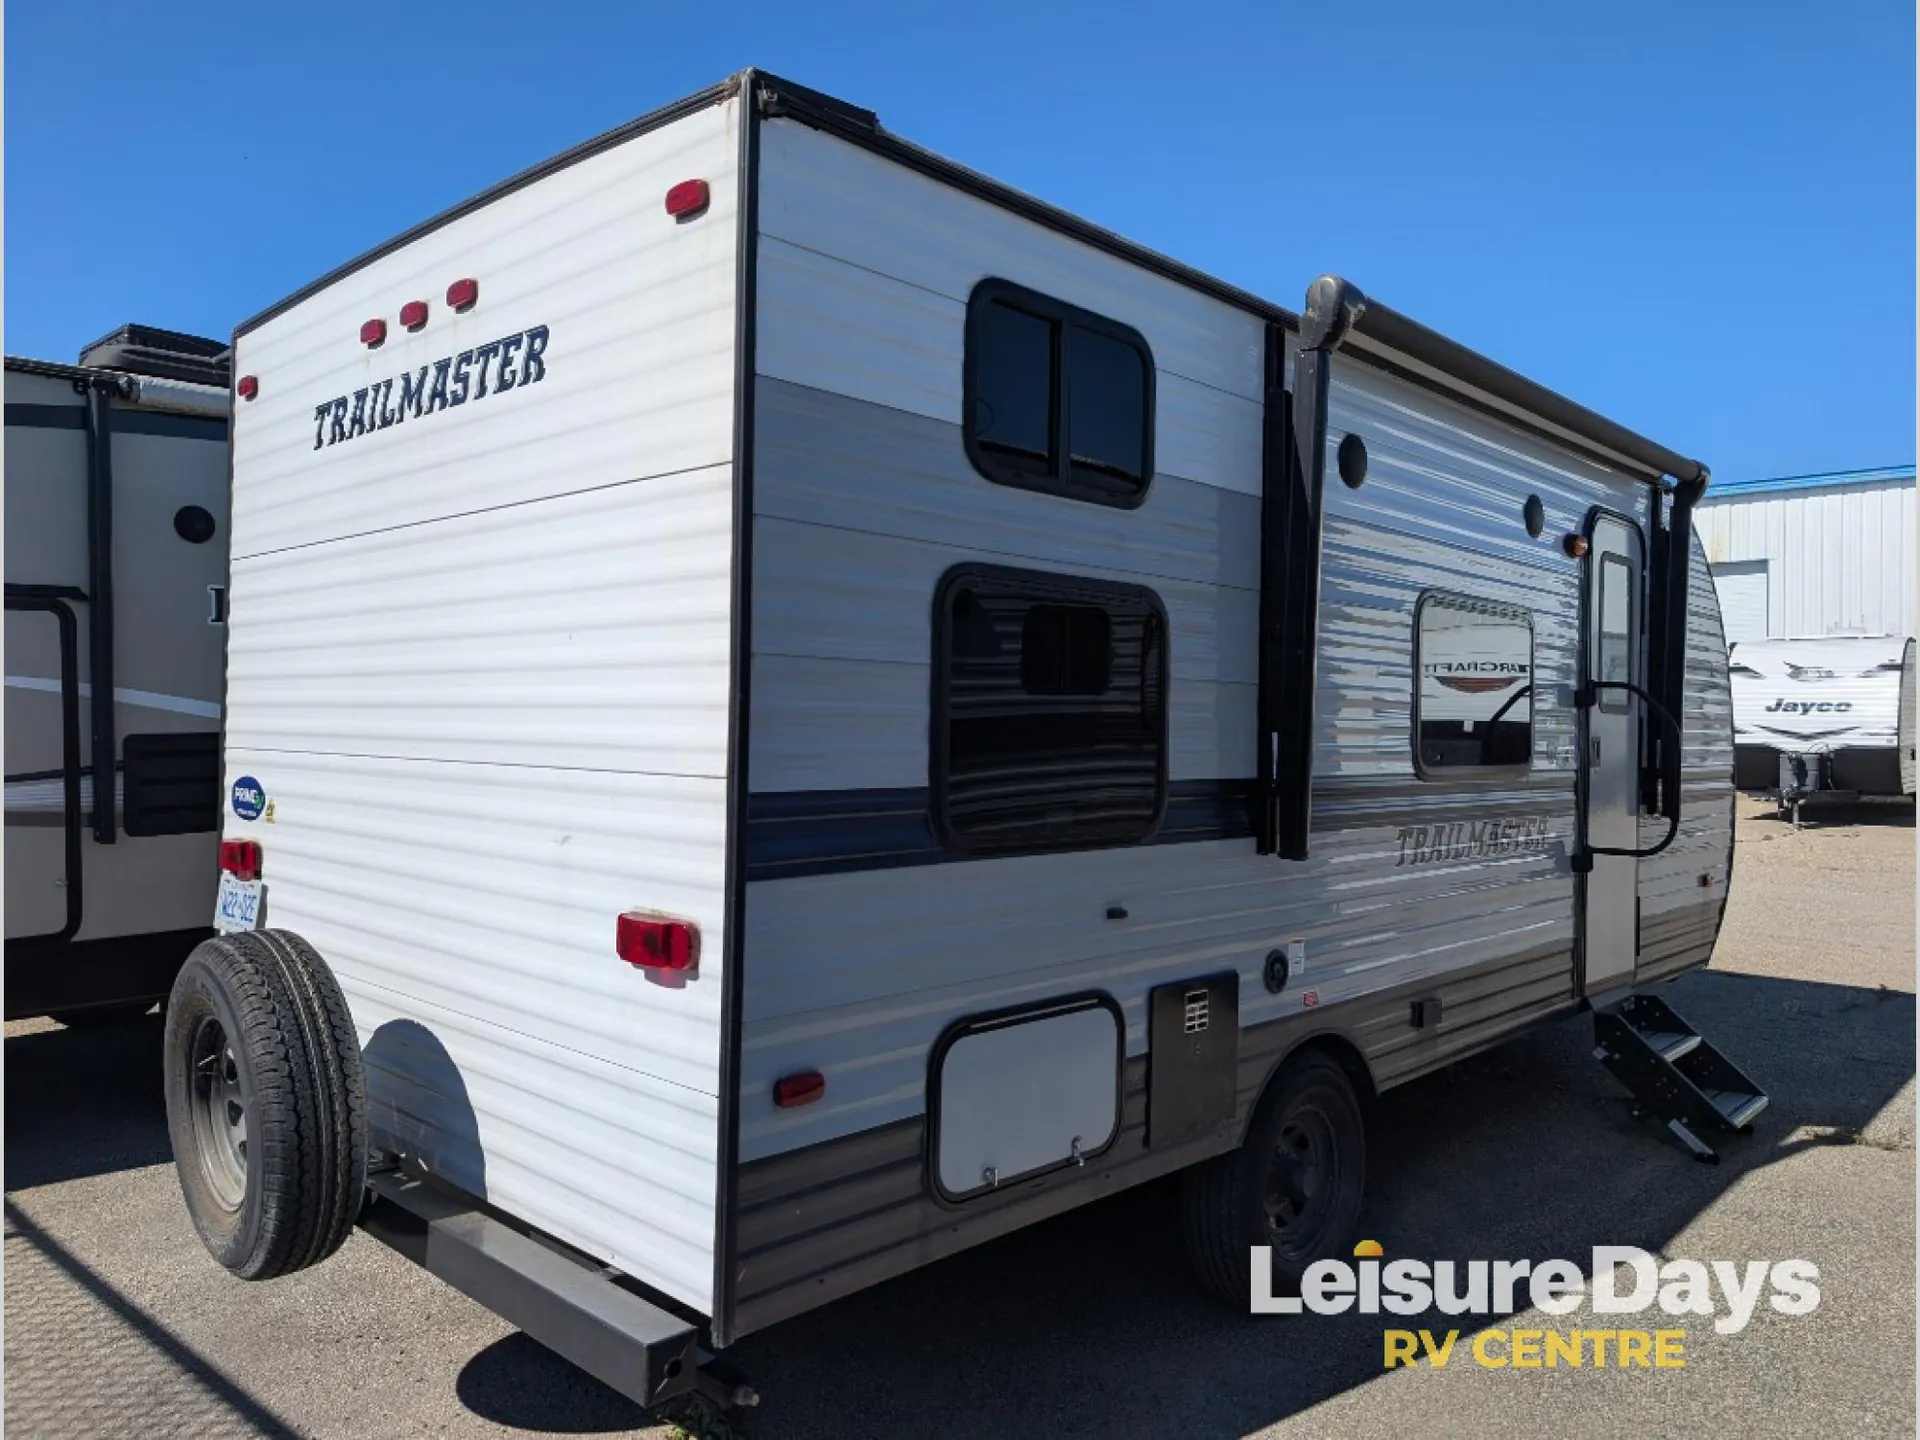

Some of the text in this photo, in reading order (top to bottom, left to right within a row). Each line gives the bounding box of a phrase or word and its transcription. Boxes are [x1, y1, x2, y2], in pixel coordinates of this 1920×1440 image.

[313, 324, 550, 451] TRAILMASTER
[1765, 698, 1852, 715] Jayco
[1395, 816, 1549, 867] TRAILMASTER
